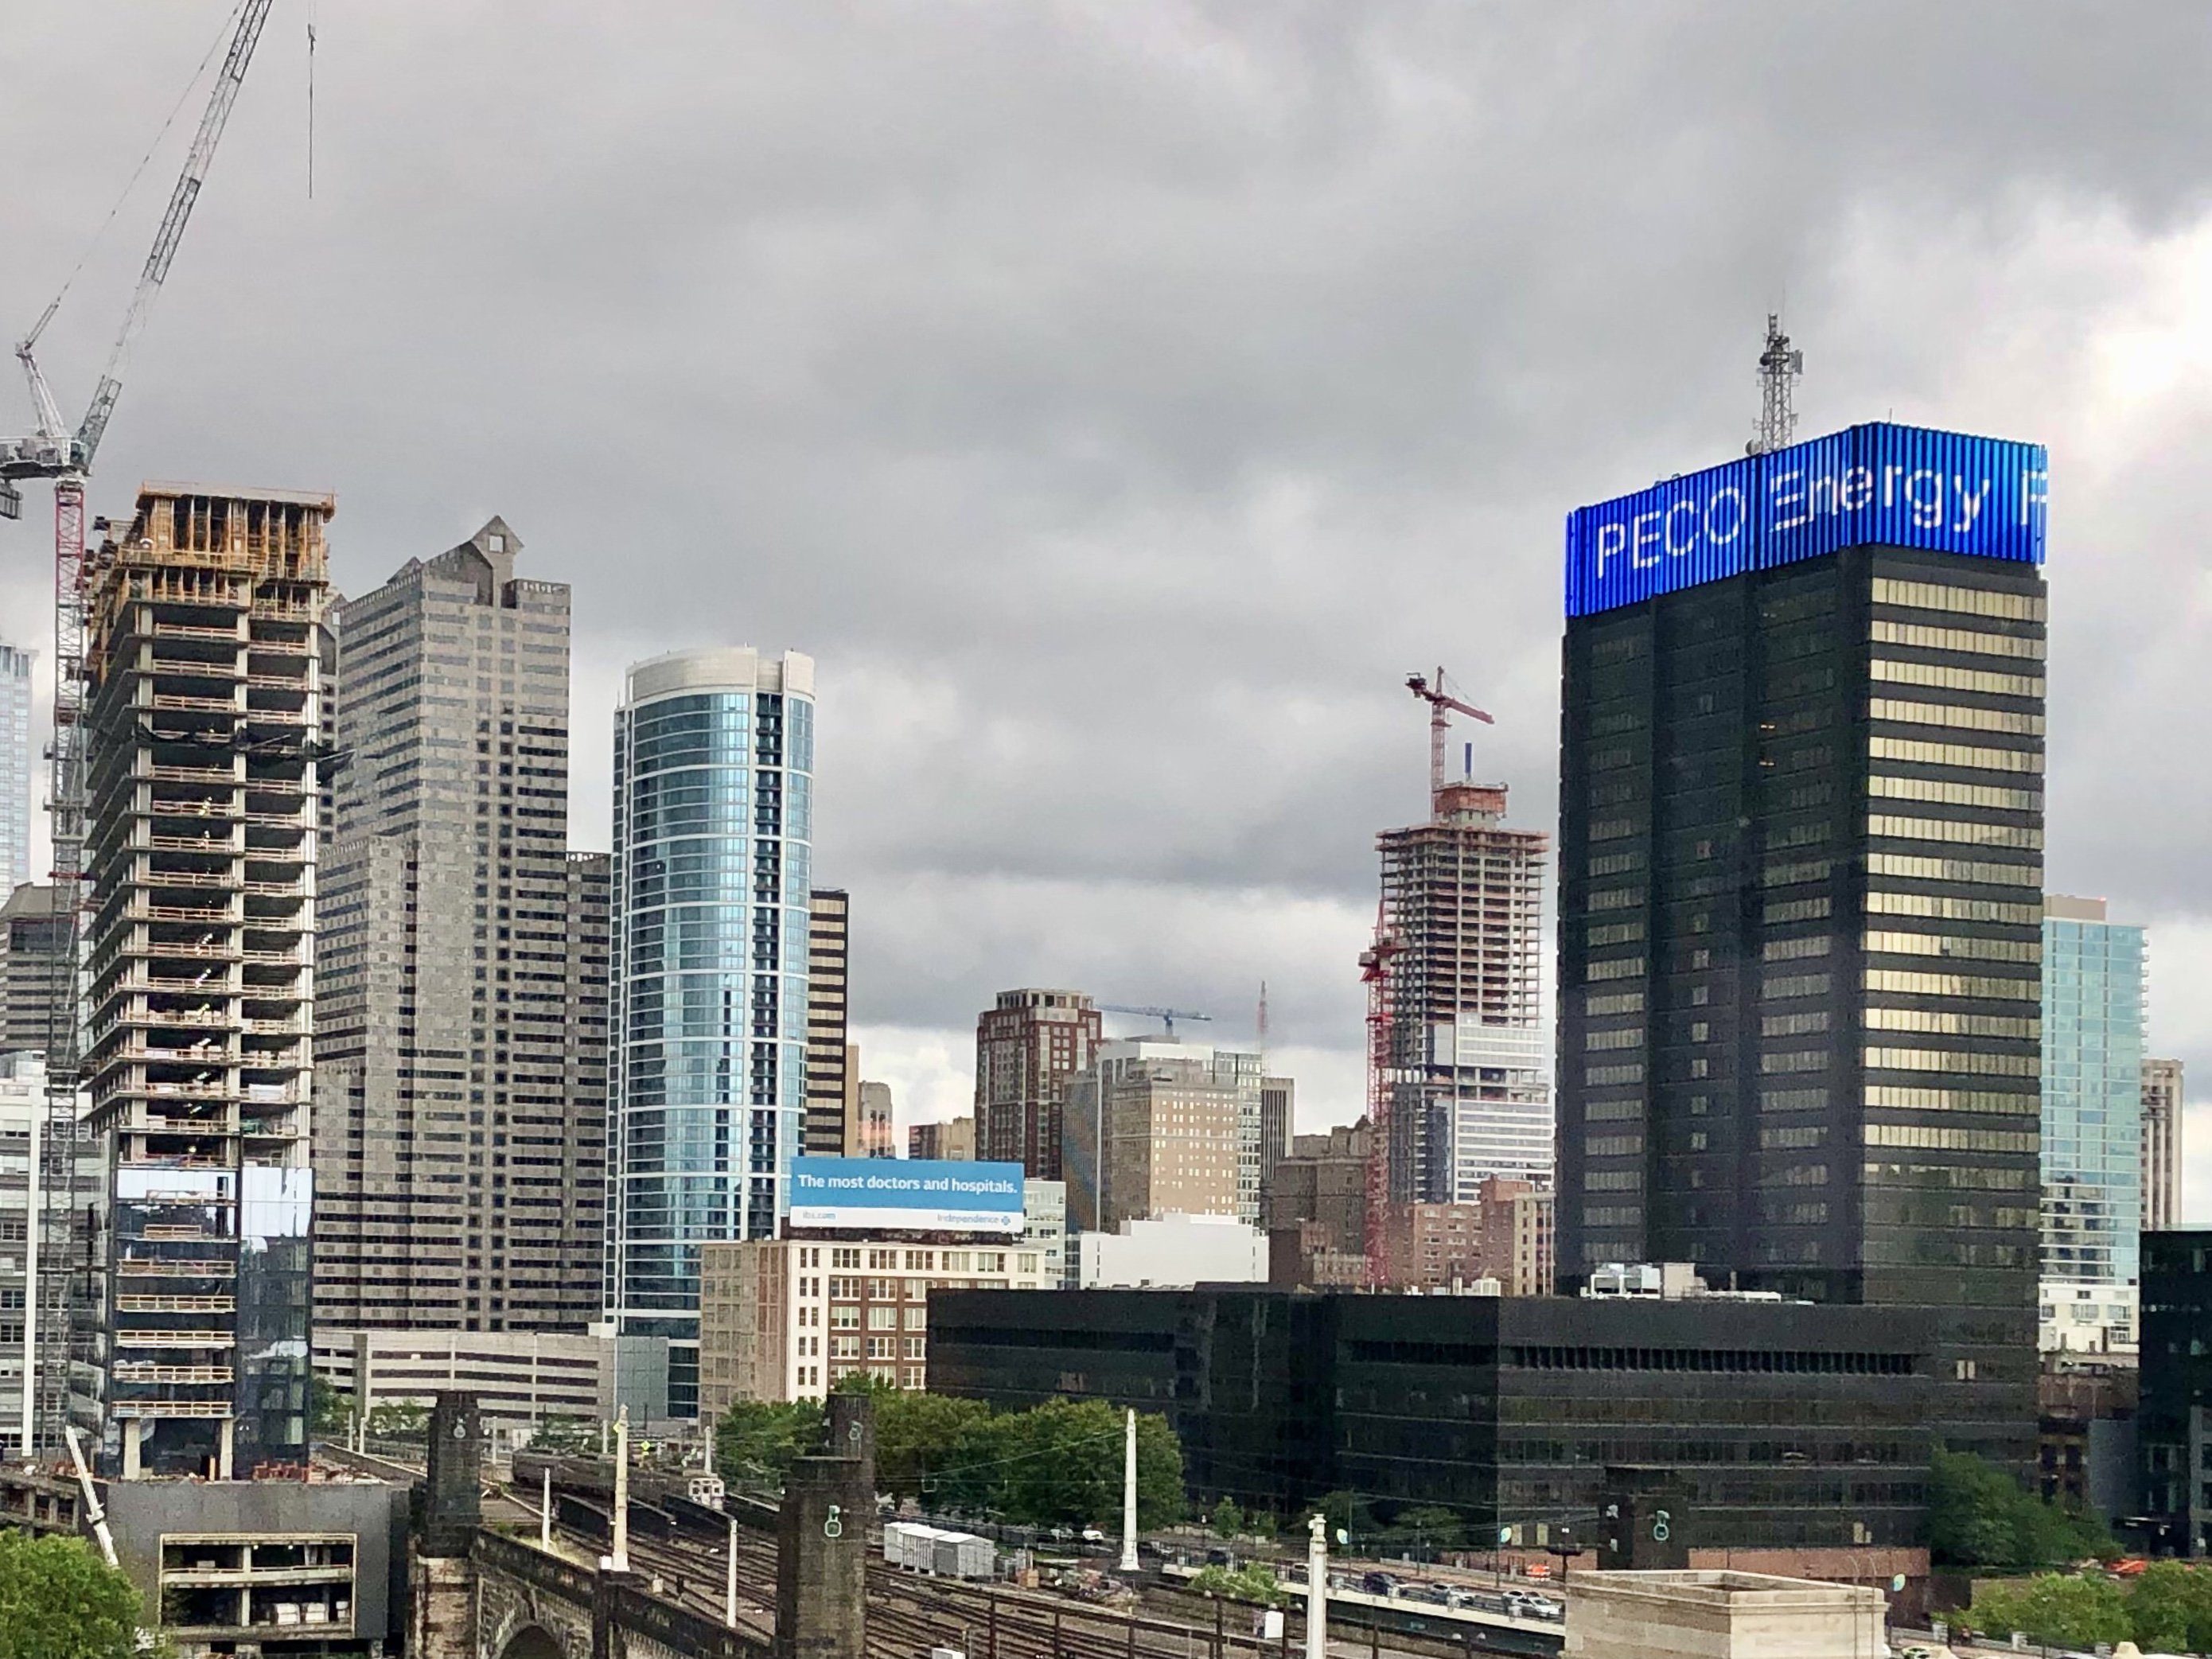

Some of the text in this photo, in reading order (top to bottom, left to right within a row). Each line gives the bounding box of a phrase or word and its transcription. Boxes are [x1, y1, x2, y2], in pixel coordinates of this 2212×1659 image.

[1597, 487, 1746, 578] PECO
[1772, 465, 1990, 532] Energy
[798, 1174, 1018, 1195] The most doctors and hospitals.
